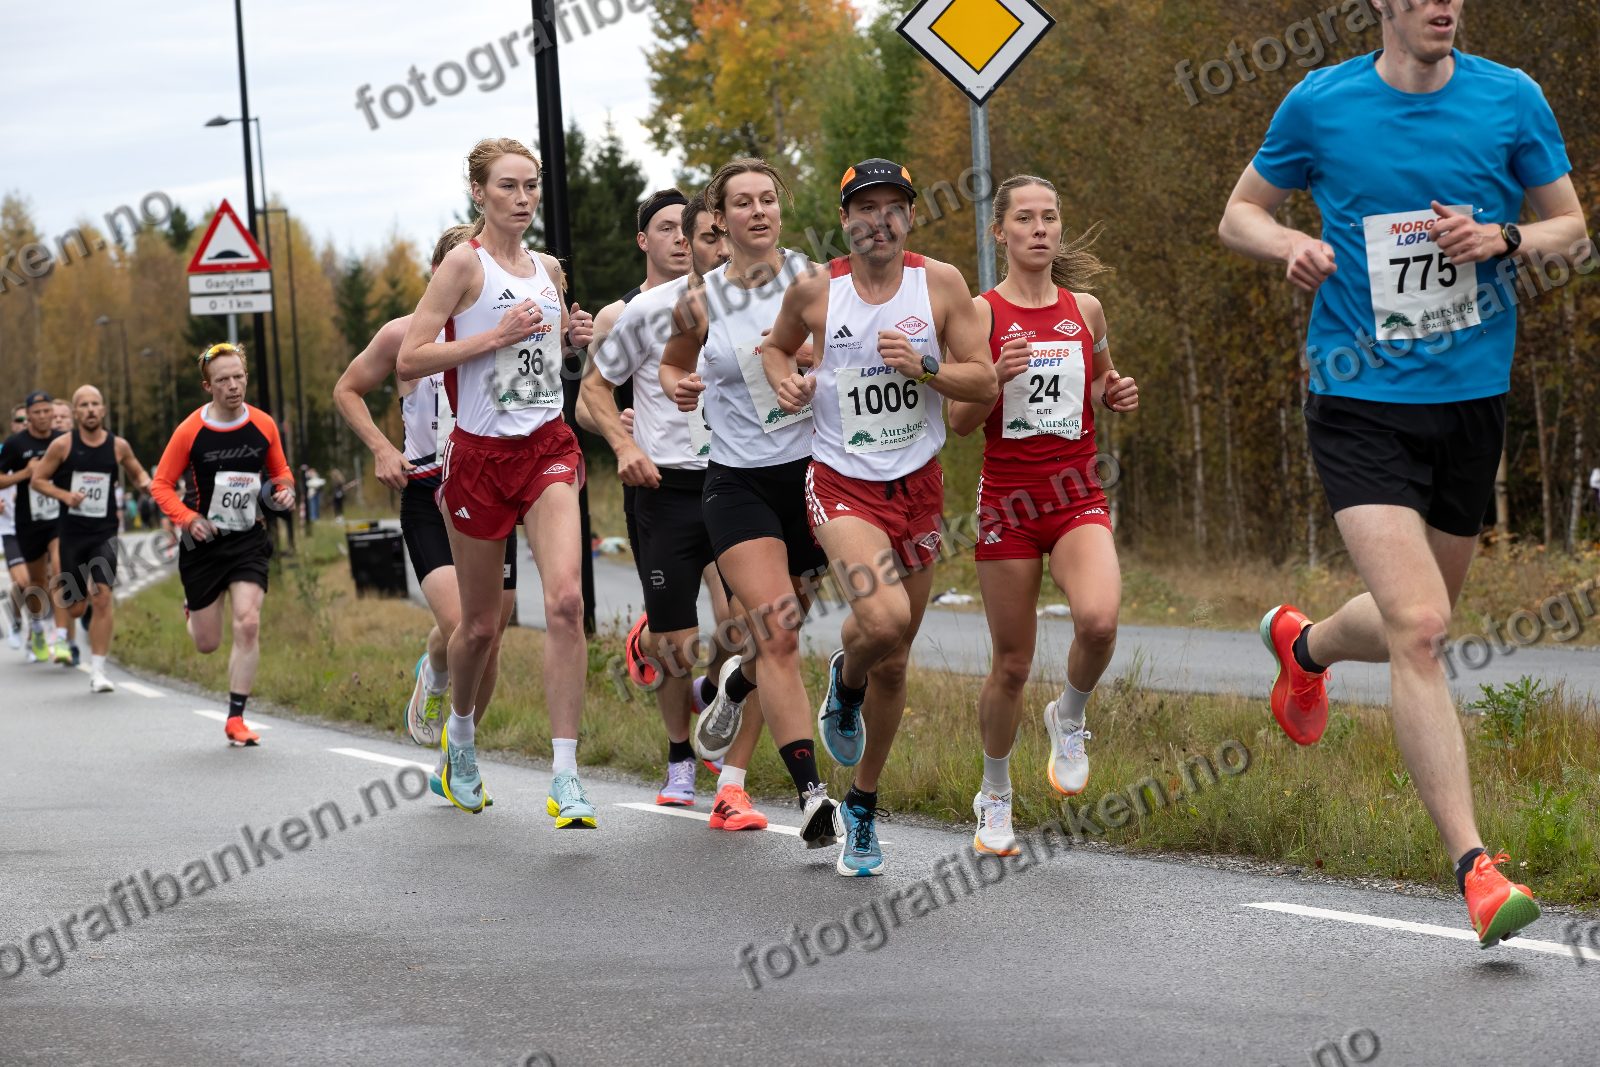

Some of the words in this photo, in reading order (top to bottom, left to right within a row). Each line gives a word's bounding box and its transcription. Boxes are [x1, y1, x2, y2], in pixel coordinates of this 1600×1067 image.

[1389, 252, 1457, 294] 775
[1421, 301, 1474, 321] Aurskog
[517, 348, 544, 377] 36
[1031, 348, 1070, 358] ORGES
[847, 379, 919, 416] 1006
[1028, 374, 1060, 403] 24
[880, 420, 924, 438] Aurskog
[1037, 417, 1080, 430] Aurskog
[222, 492, 250, 510] 602
